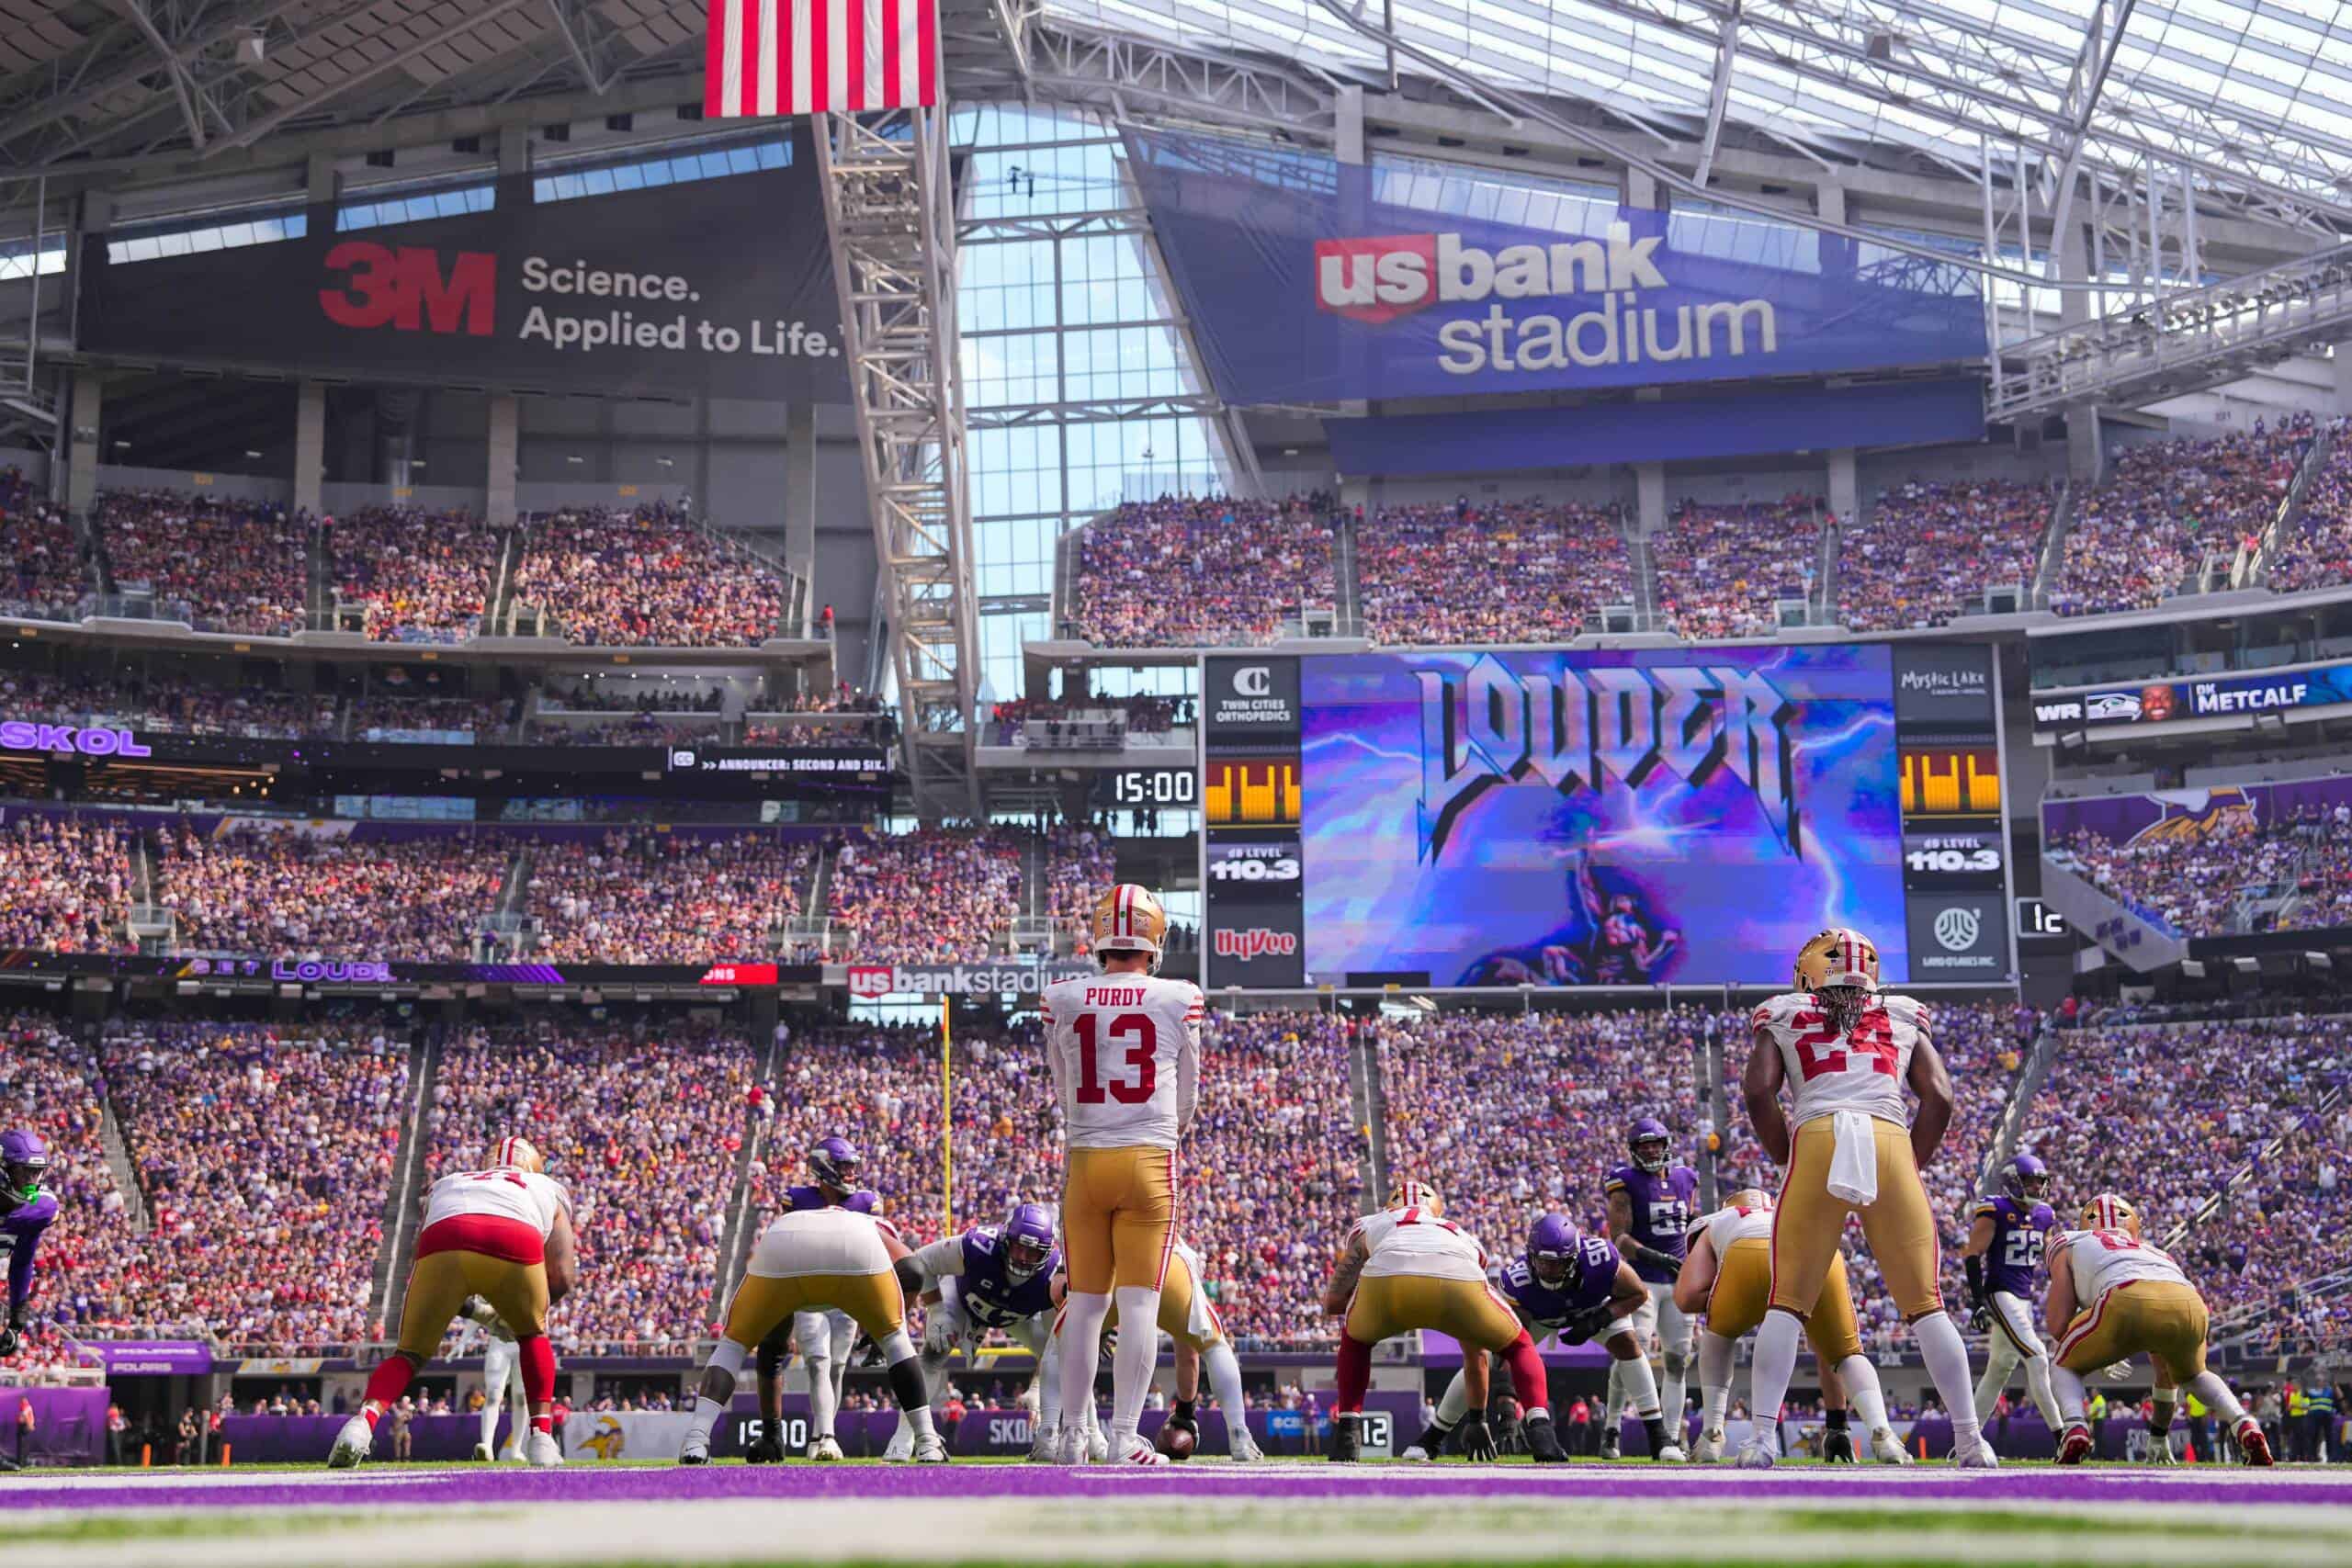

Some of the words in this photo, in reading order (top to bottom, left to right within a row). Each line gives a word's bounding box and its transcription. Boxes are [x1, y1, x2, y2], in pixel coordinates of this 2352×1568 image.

[319, 242, 497, 336] 3M
[521, 256, 700, 301] Science.
[519, 305, 687, 352] Applied
[697, 314, 741, 353] to
[751, 319, 840, 357] Life.
[1438, 290, 1777, 375] stadium
[2196, 682, 2215, 695] DK
[2198, 684, 2307, 714] METCALF
[1216, 710, 1291, 722] ORTHOPEDICS
[1222, 699, 1250, 710] TWIN
[1251, 699, 1285, 710] CITIES
[2035, 703, 2082, 722] WR
[0, 721, 152, 757] SKOL
[718, 758, 790, 771] ANNOUNCER:
[792, 759, 835, 772] SECOND
[837, 760, 861, 772] AND
[863, 760, 886, 772] SIX.
[1413, 653, 1803, 865] LOUDER
[1115, 772, 1193, 803] 15:00
[1246, 847, 1283, 859] LEVEL
[1943, 838, 1981, 849] LEVEL
[1210, 859, 1300, 880] 110.3
[1906, 850, 2000, 871] 110.3
[1084, 987, 1147, 1007] PURDY
[1073, 1013, 1158, 1104] 13
[2004, 1230, 2044, 1267] 22
[1363, 1417, 1388, 1446] 12
